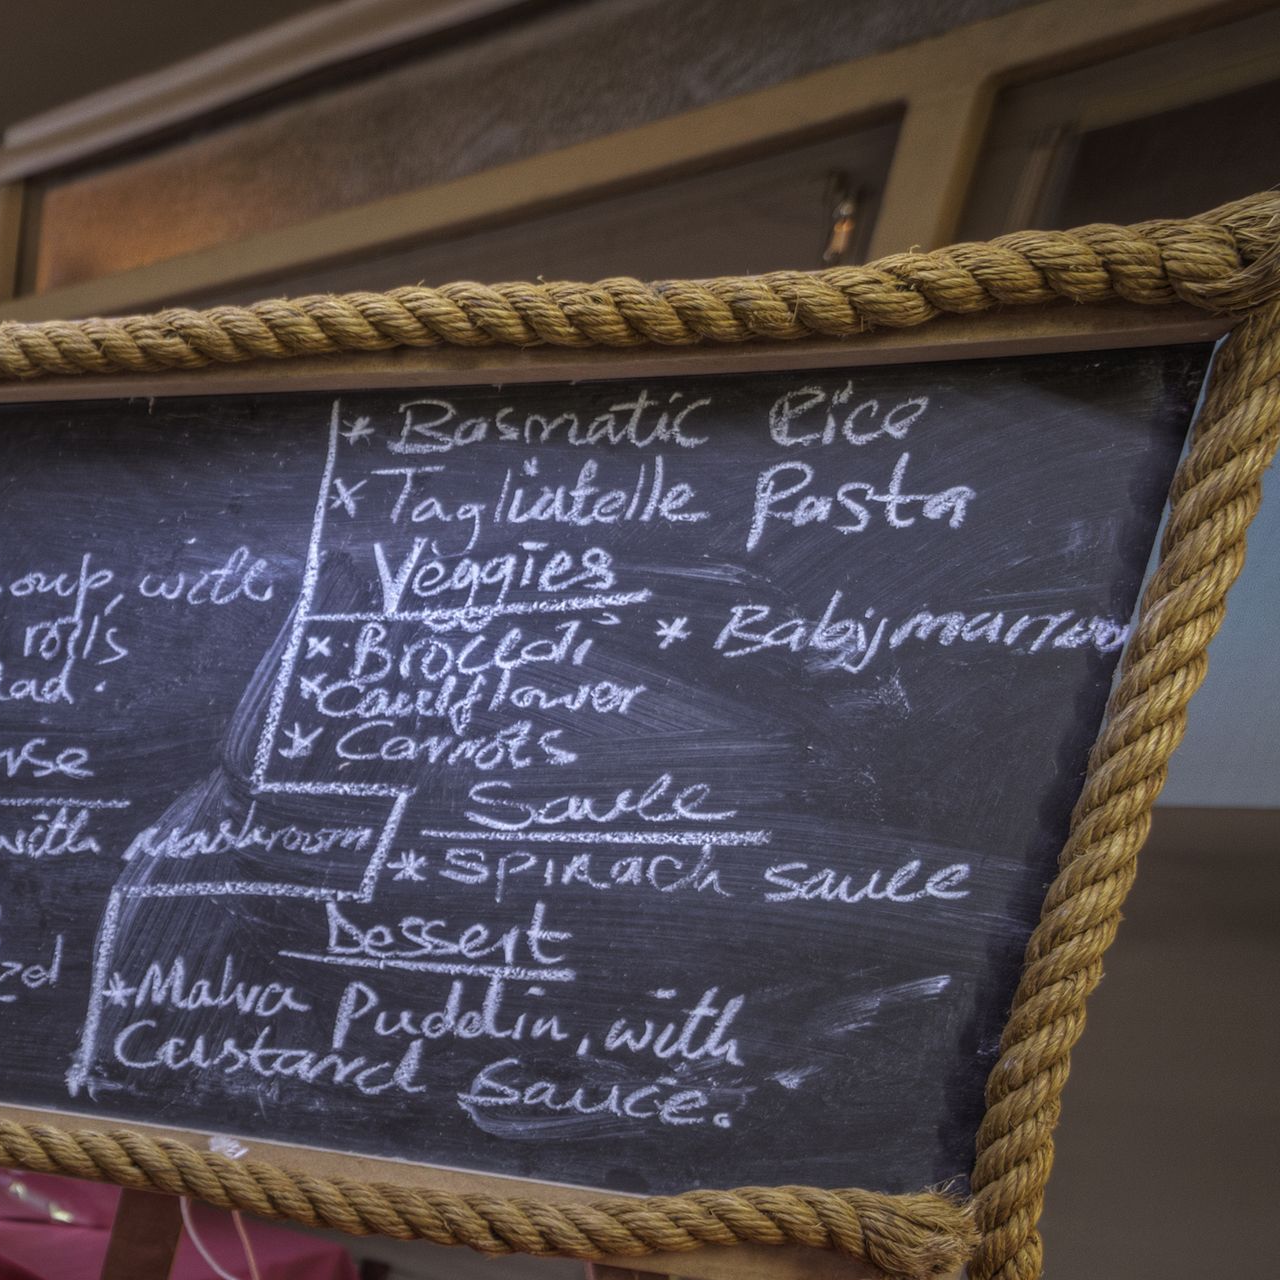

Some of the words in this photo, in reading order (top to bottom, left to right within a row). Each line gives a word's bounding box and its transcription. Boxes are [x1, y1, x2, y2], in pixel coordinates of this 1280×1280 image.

[768, 382, 930, 447] Rice
[745, 452, 977, 552] Pasta
[373, 537, 616, 632] Veggies
[336, 720, 579, 771] Carrots
[326, 900, 573, 964] Dessert
[136, 954, 311, 1017] Malva
[605, 986, 745, 1067] with
[113, 1020, 427, 1096] Custard
